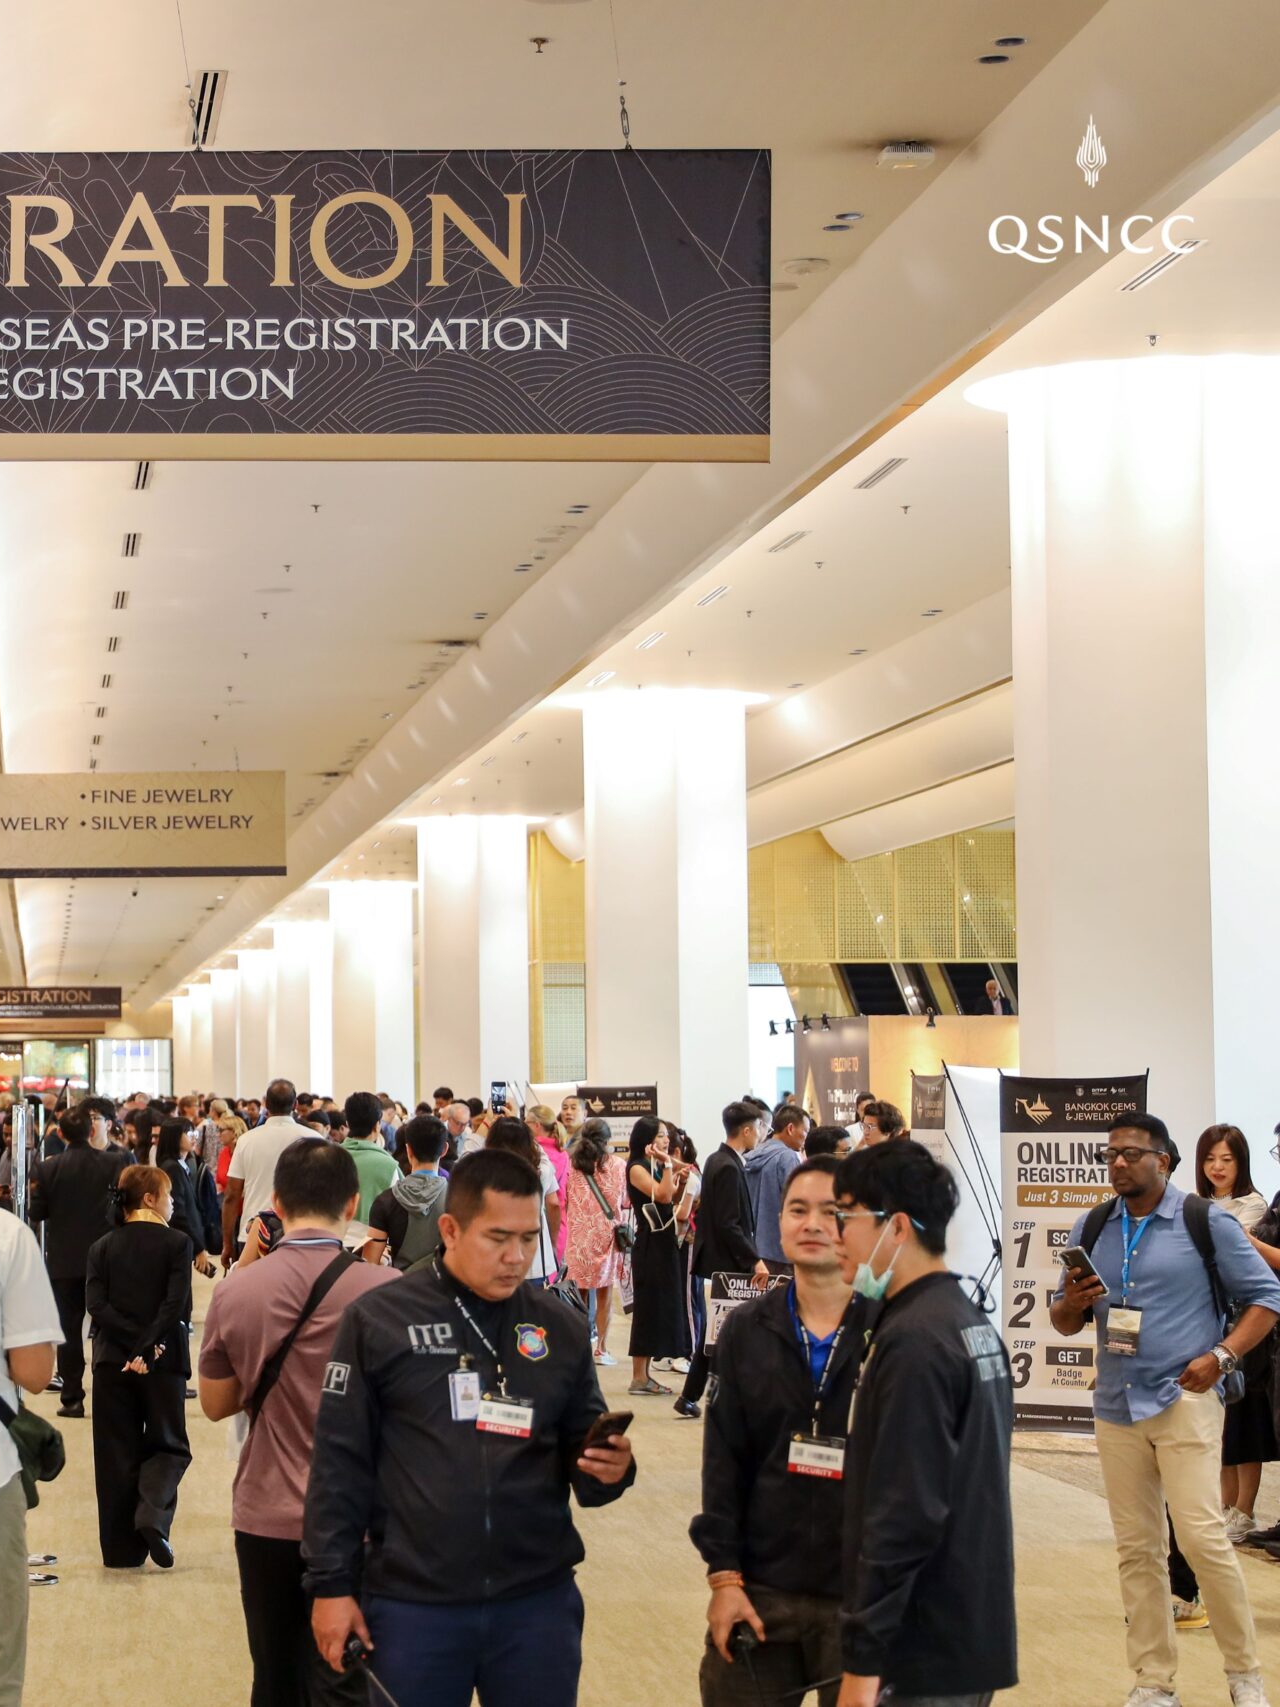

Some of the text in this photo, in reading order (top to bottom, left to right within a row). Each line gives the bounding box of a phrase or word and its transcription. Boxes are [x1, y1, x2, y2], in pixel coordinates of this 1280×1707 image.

[123, 317, 570, 351] PRE-REGISTRATION
[91, 788, 234, 804] FINE JEWELRY
[91, 814, 254, 831] SILVER JEWELRY
[1064, 1102, 1137, 1111] BANGKOK GEMS
[1073, 1112, 1115, 1121] JEWELRY
[1017, 1167, 1112, 1184] REGISTRAT
[1024, 1191, 1046, 1203] Just
[1049, 1189, 1059, 1205] 3
[1062, 1191, 1098, 1205] Simple
[1012, 1221, 1036, 1231] STEP
[1013, 1232, 1031, 1269] 1
[729, 1278, 767, 1290] ONLI
[1012, 1280, 1036, 1289] STEP
[1008, 1291, 1036, 1329] 2
[407, 1322, 453, 1346] ITP
[1012, 1340, 1036, 1350] STEP
[1058, 1350, 1081, 1364] GET
[323, 1365, 346, 1389] TP
[1011, 1352, 1033, 1389] 3
[1056, 1368, 1083, 1379] Badge
[1051, 1378, 1088, 1387] At Counter
[485, 1422, 521, 1436] SECURITY
[796, 1464, 833, 1477] SECURITY
